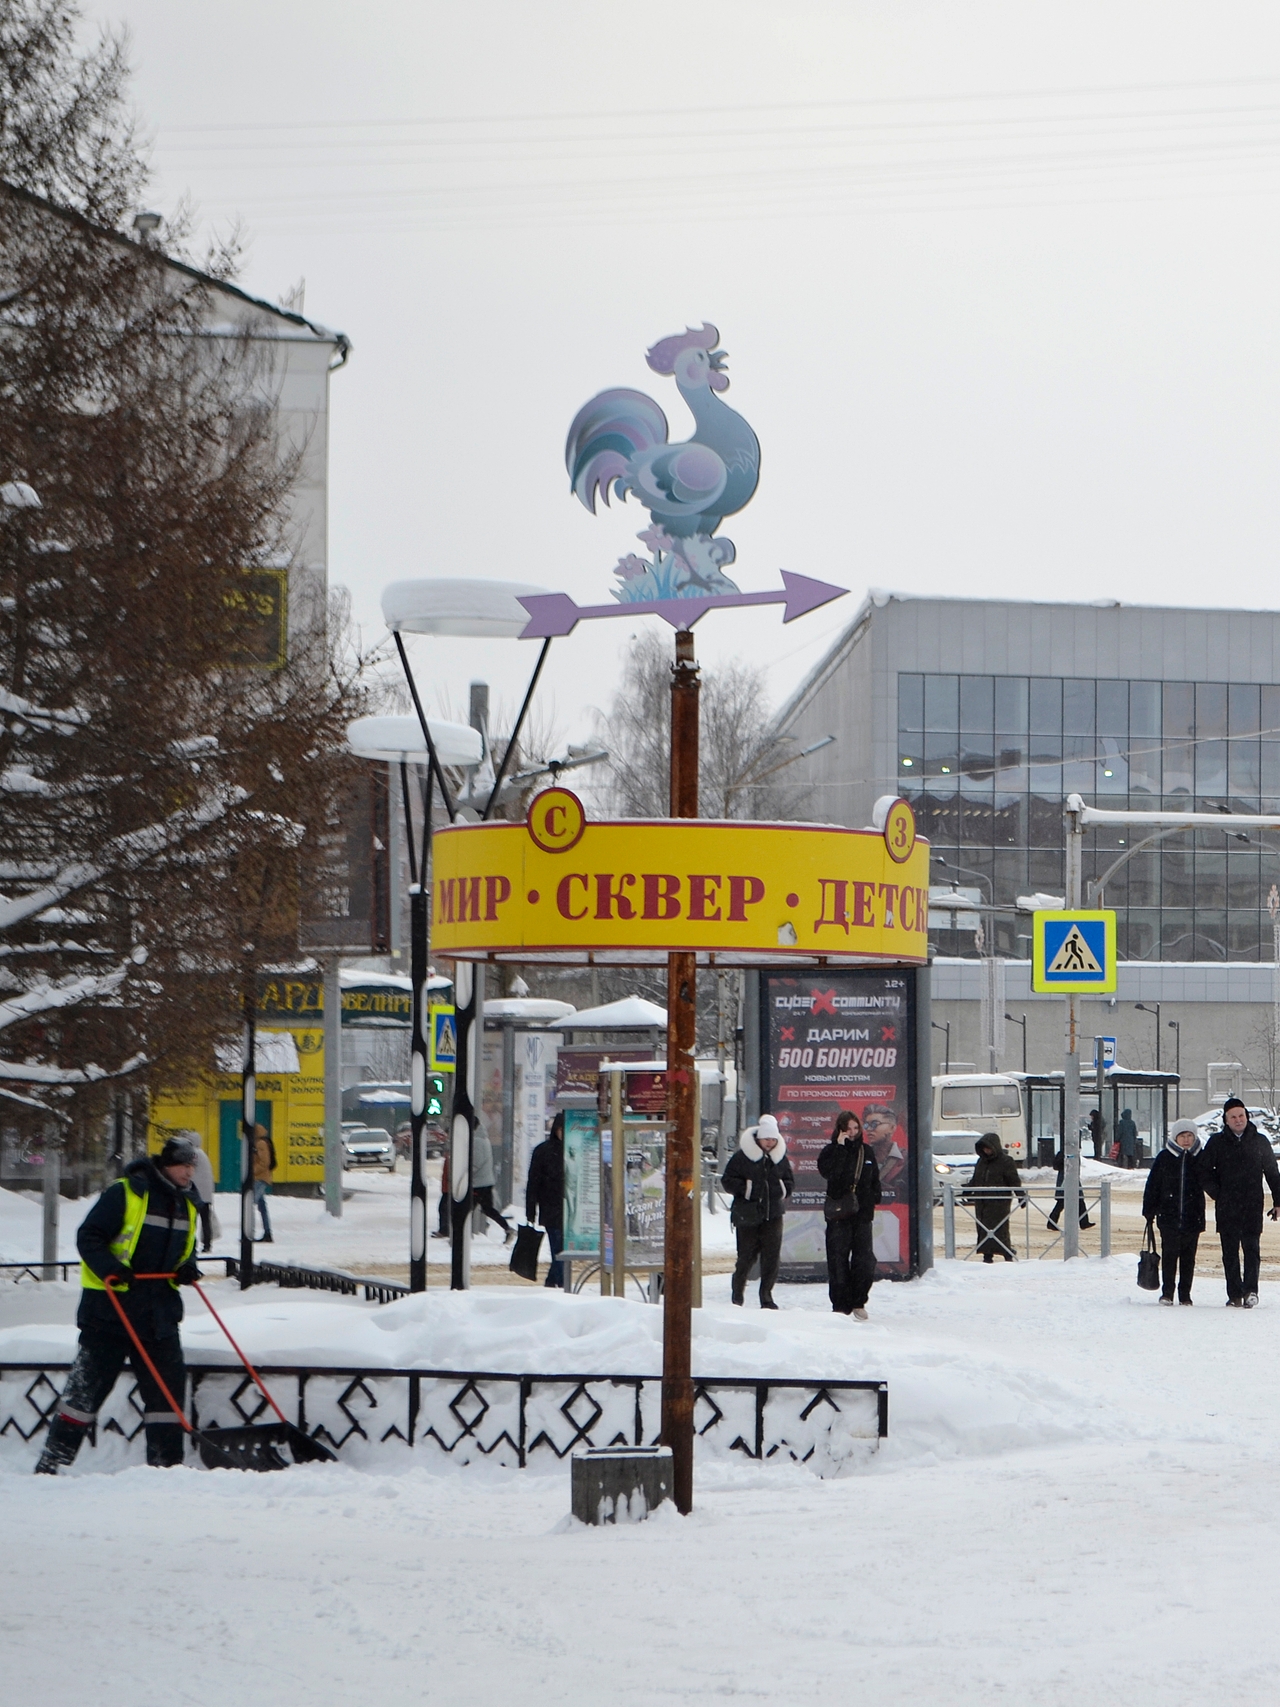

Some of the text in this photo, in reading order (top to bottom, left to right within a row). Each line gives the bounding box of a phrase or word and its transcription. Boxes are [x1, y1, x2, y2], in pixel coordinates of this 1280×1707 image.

[438, 873, 929, 936] МИР СКВЕР ДЕТСК
[884, 979, 905, 988] 12+
[807, 1028, 870, 1042] ДАРИМ
[778, 1047, 898, 1068] 500 БОНУСОВ
[800, 1090, 850, 1098] ПРОМОКОДУ
